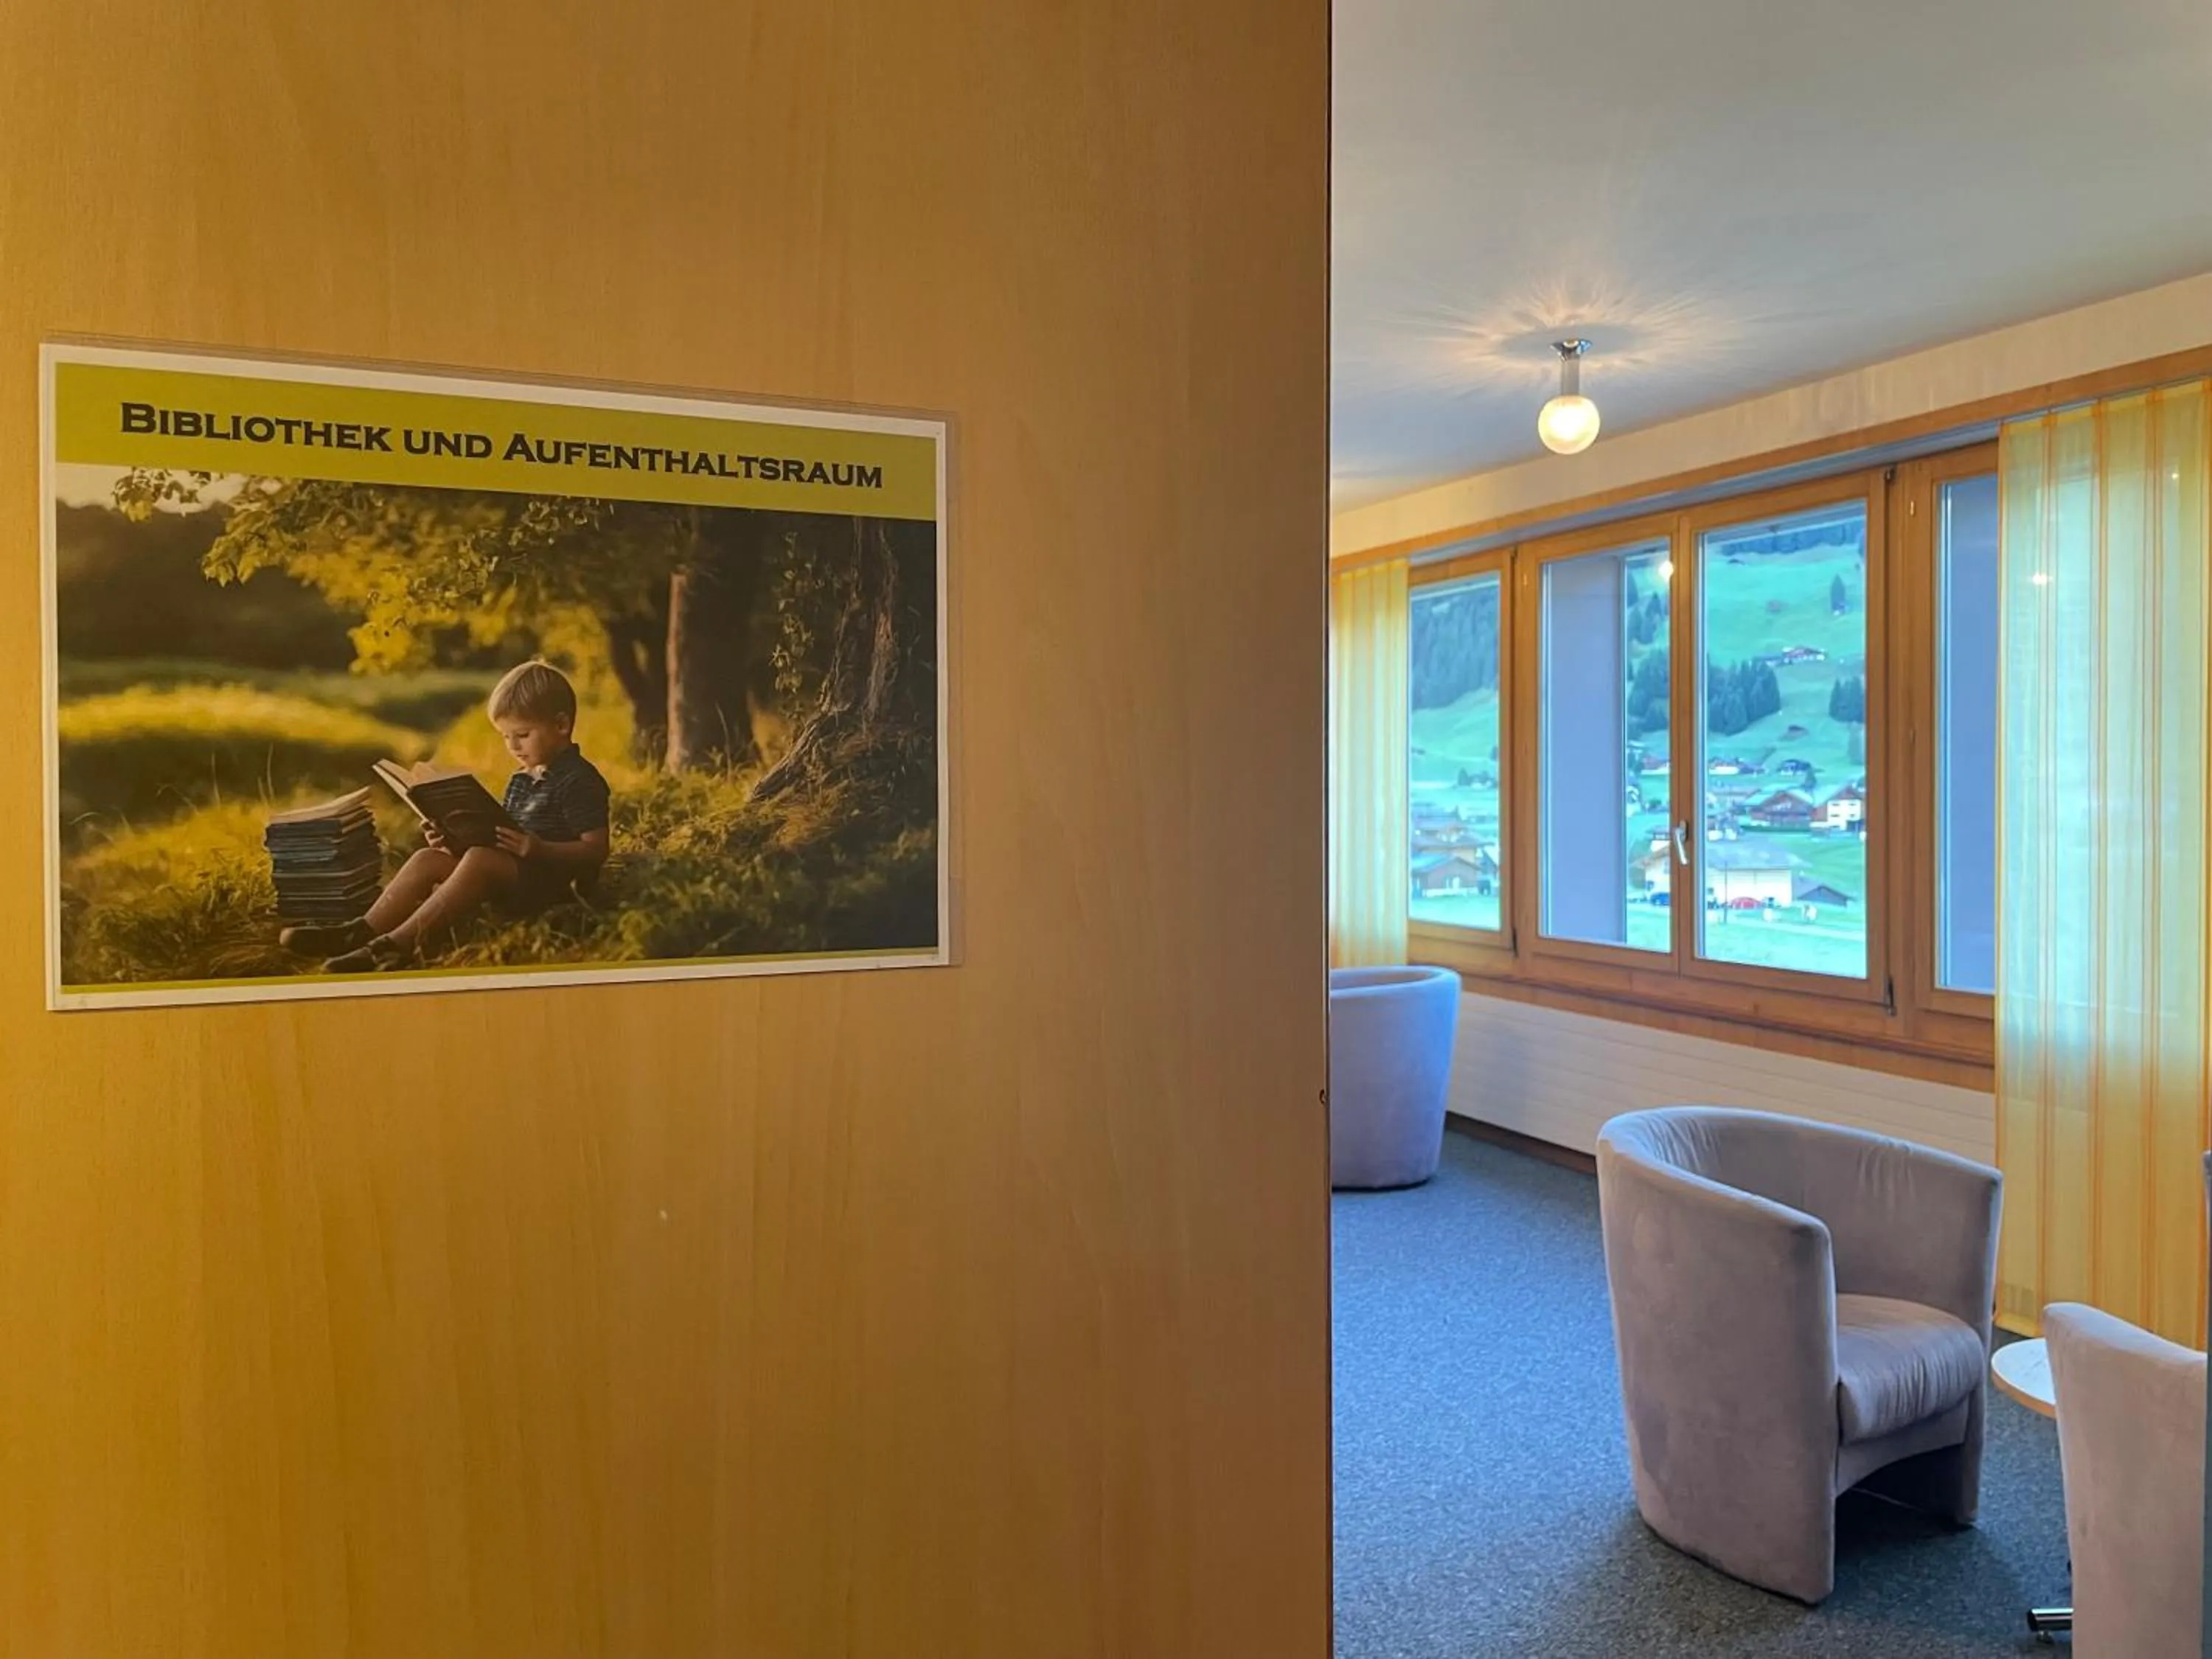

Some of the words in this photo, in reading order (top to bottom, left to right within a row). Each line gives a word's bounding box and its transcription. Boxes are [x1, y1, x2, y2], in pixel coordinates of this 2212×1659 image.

[120, 401, 394, 453] BIBLIOTHEK
[403, 428, 493, 460] UND
[502, 432, 883, 490] AUFENTHALTSRAUM
